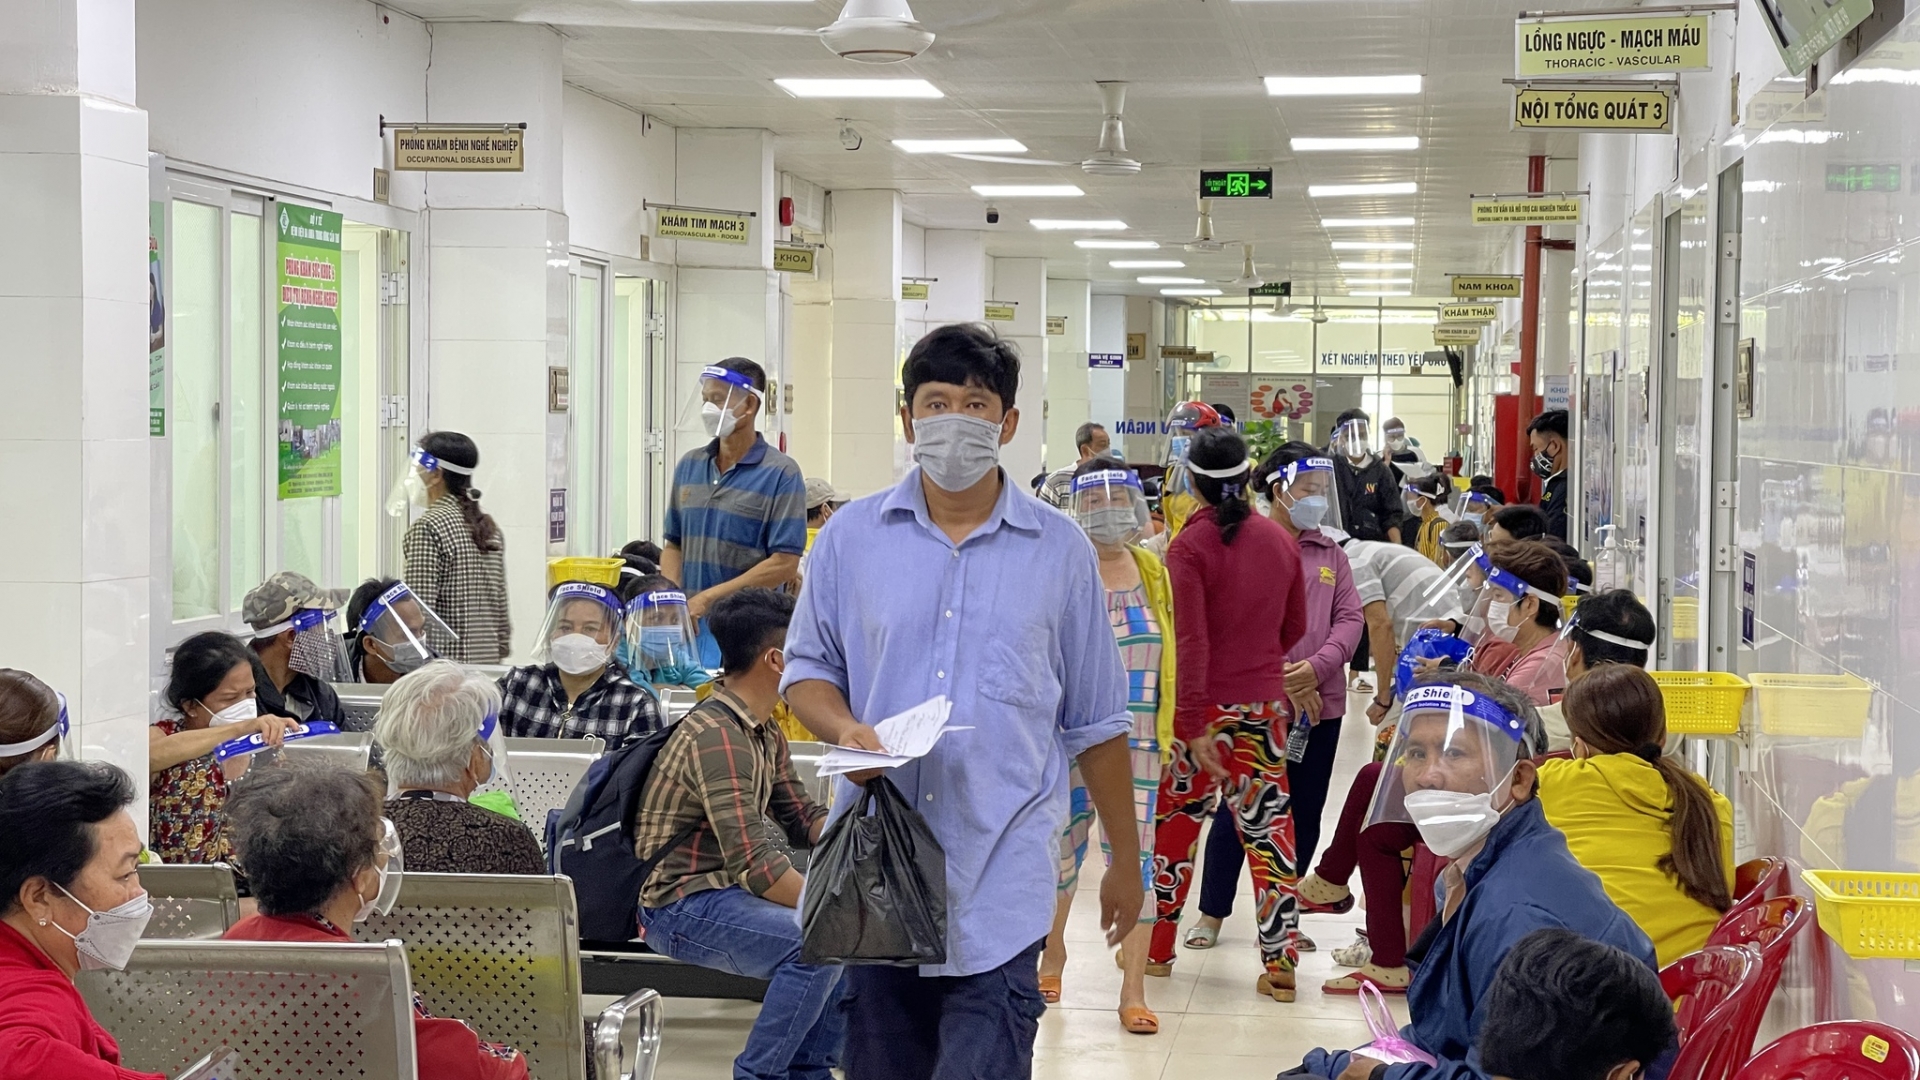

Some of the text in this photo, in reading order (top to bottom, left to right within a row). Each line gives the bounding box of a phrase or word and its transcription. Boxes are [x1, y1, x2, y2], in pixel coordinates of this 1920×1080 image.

[1567, 30, 1605, 54] NGỰC
[1621, 29, 1663, 52] MẠCH
[1668, 24, 1700, 46] MÁU
[1545, 57, 1605, 68] THORACIC
[1617, 55, 1680, 66] VASCULAR
[1521, 92, 1663, 123] NỘI TỔNG QUÁT 3
[427, 137, 447, 150] KHÁM
[450, 137, 469, 153] BỆNH
[492, 138, 518, 154] NGHIỆP
[406, 156, 459, 164] OCCUPATIONAL
[661, 215, 745, 233] KHÁM TIM MẠCH 3
[661, 230, 716, 238] CARDIOVASCULAR
[780, 254, 807, 263] KHOA
[1458, 283, 1514, 291] NAM KHOA
[1444, 306, 1495, 318] KHÁM THẬN
[1321, 350, 1339, 366] XÉT
[1341, 350, 1378, 368] NGHIỆM
[1382, 353, 1405, 366] THEO
[1408, 351, 1425, 366] YÊU
